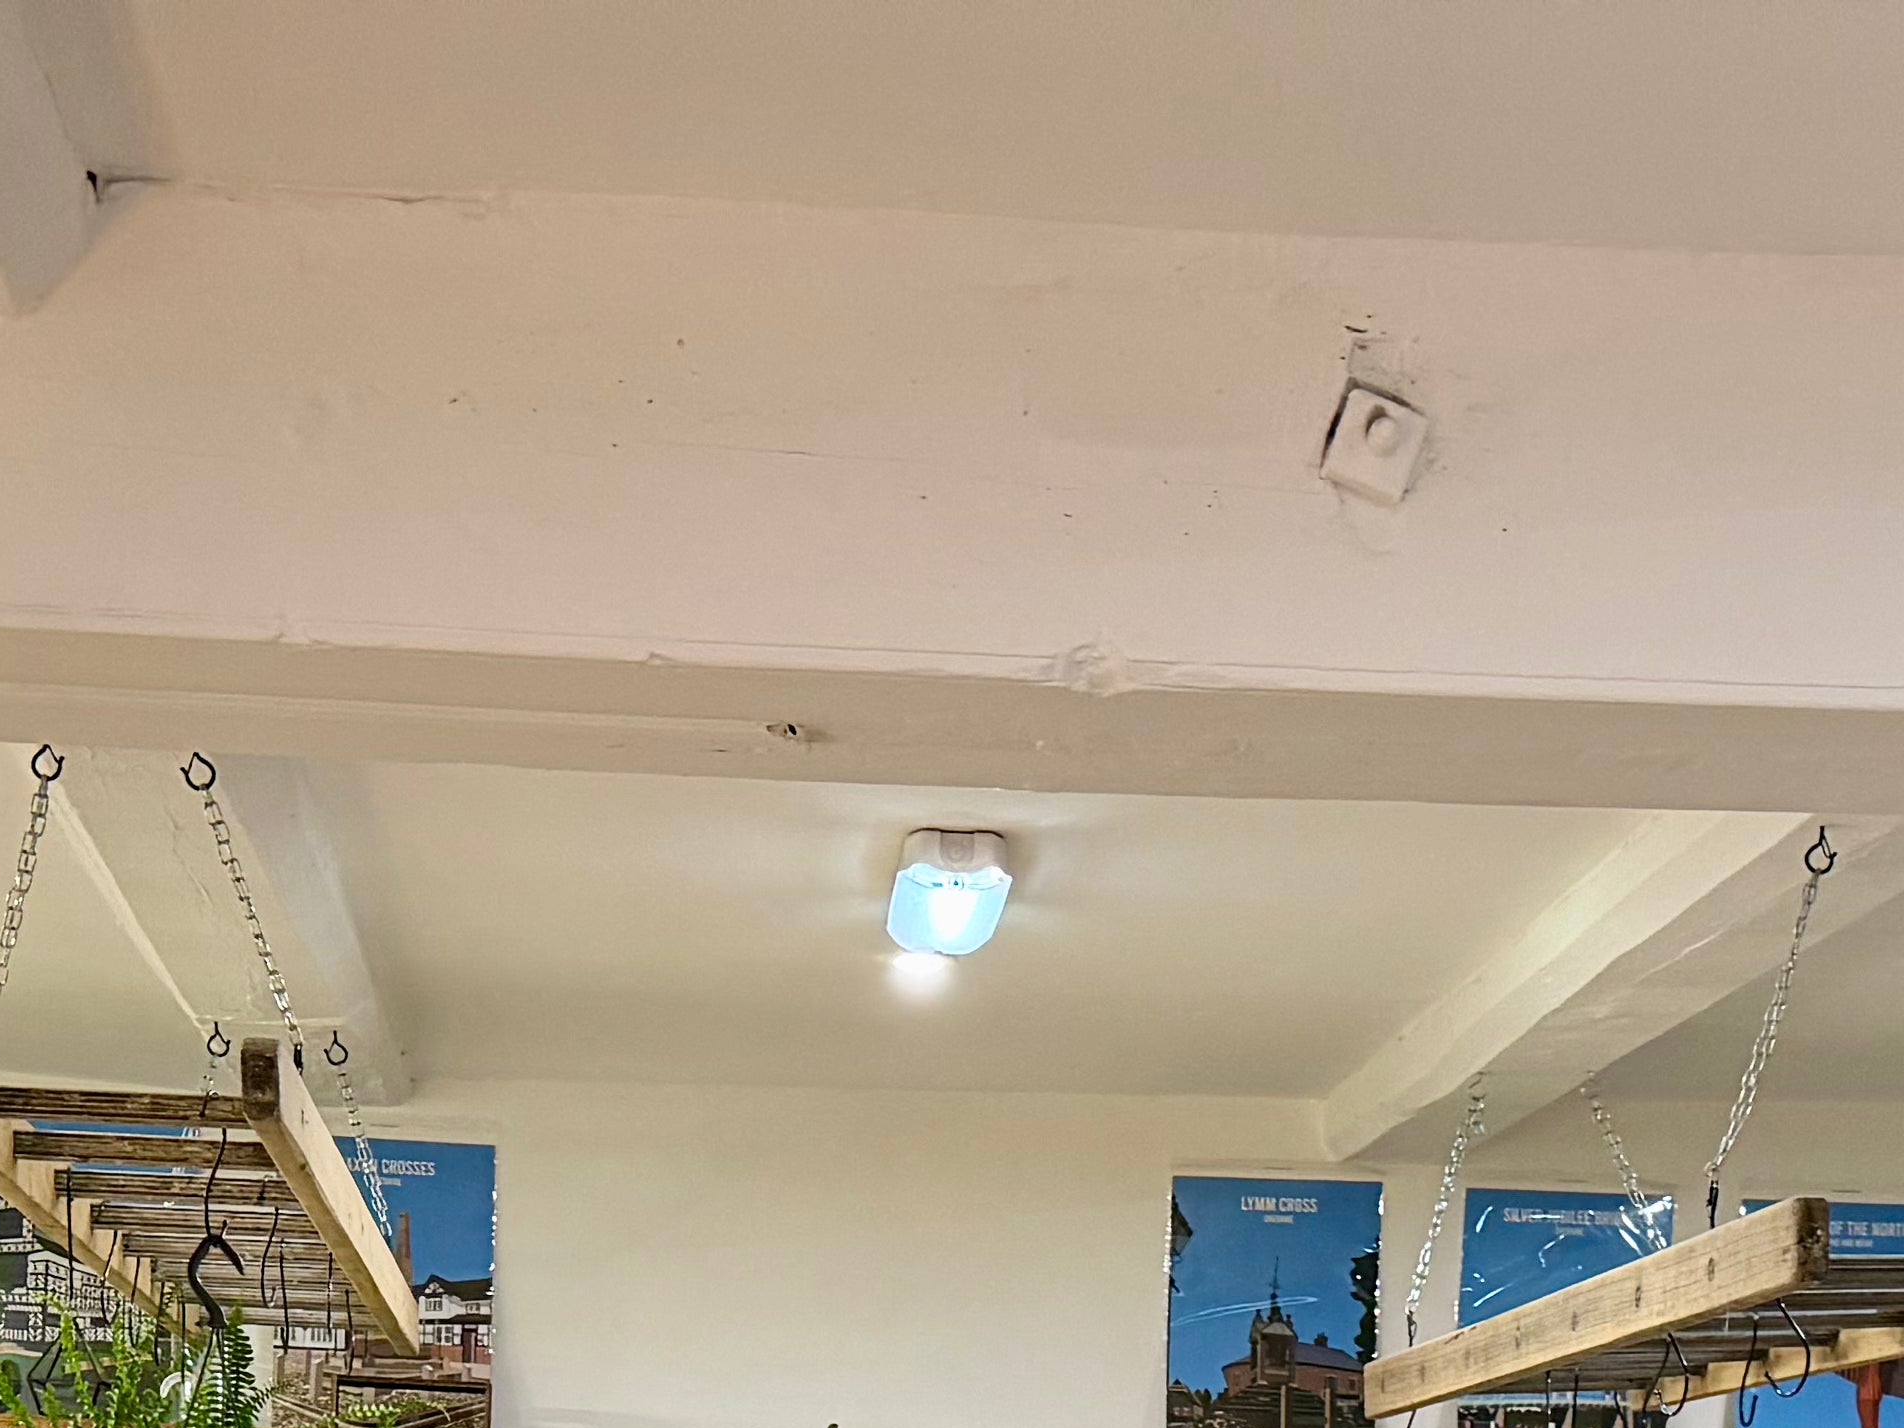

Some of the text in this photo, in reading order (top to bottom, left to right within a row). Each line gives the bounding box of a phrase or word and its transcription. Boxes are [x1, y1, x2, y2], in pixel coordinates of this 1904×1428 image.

[381, 1158, 436, 1176] CROSSES
[1241, 1195, 1318, 1214] LYMM CROSS
[1846, 1221, 1869, 1237] THE
